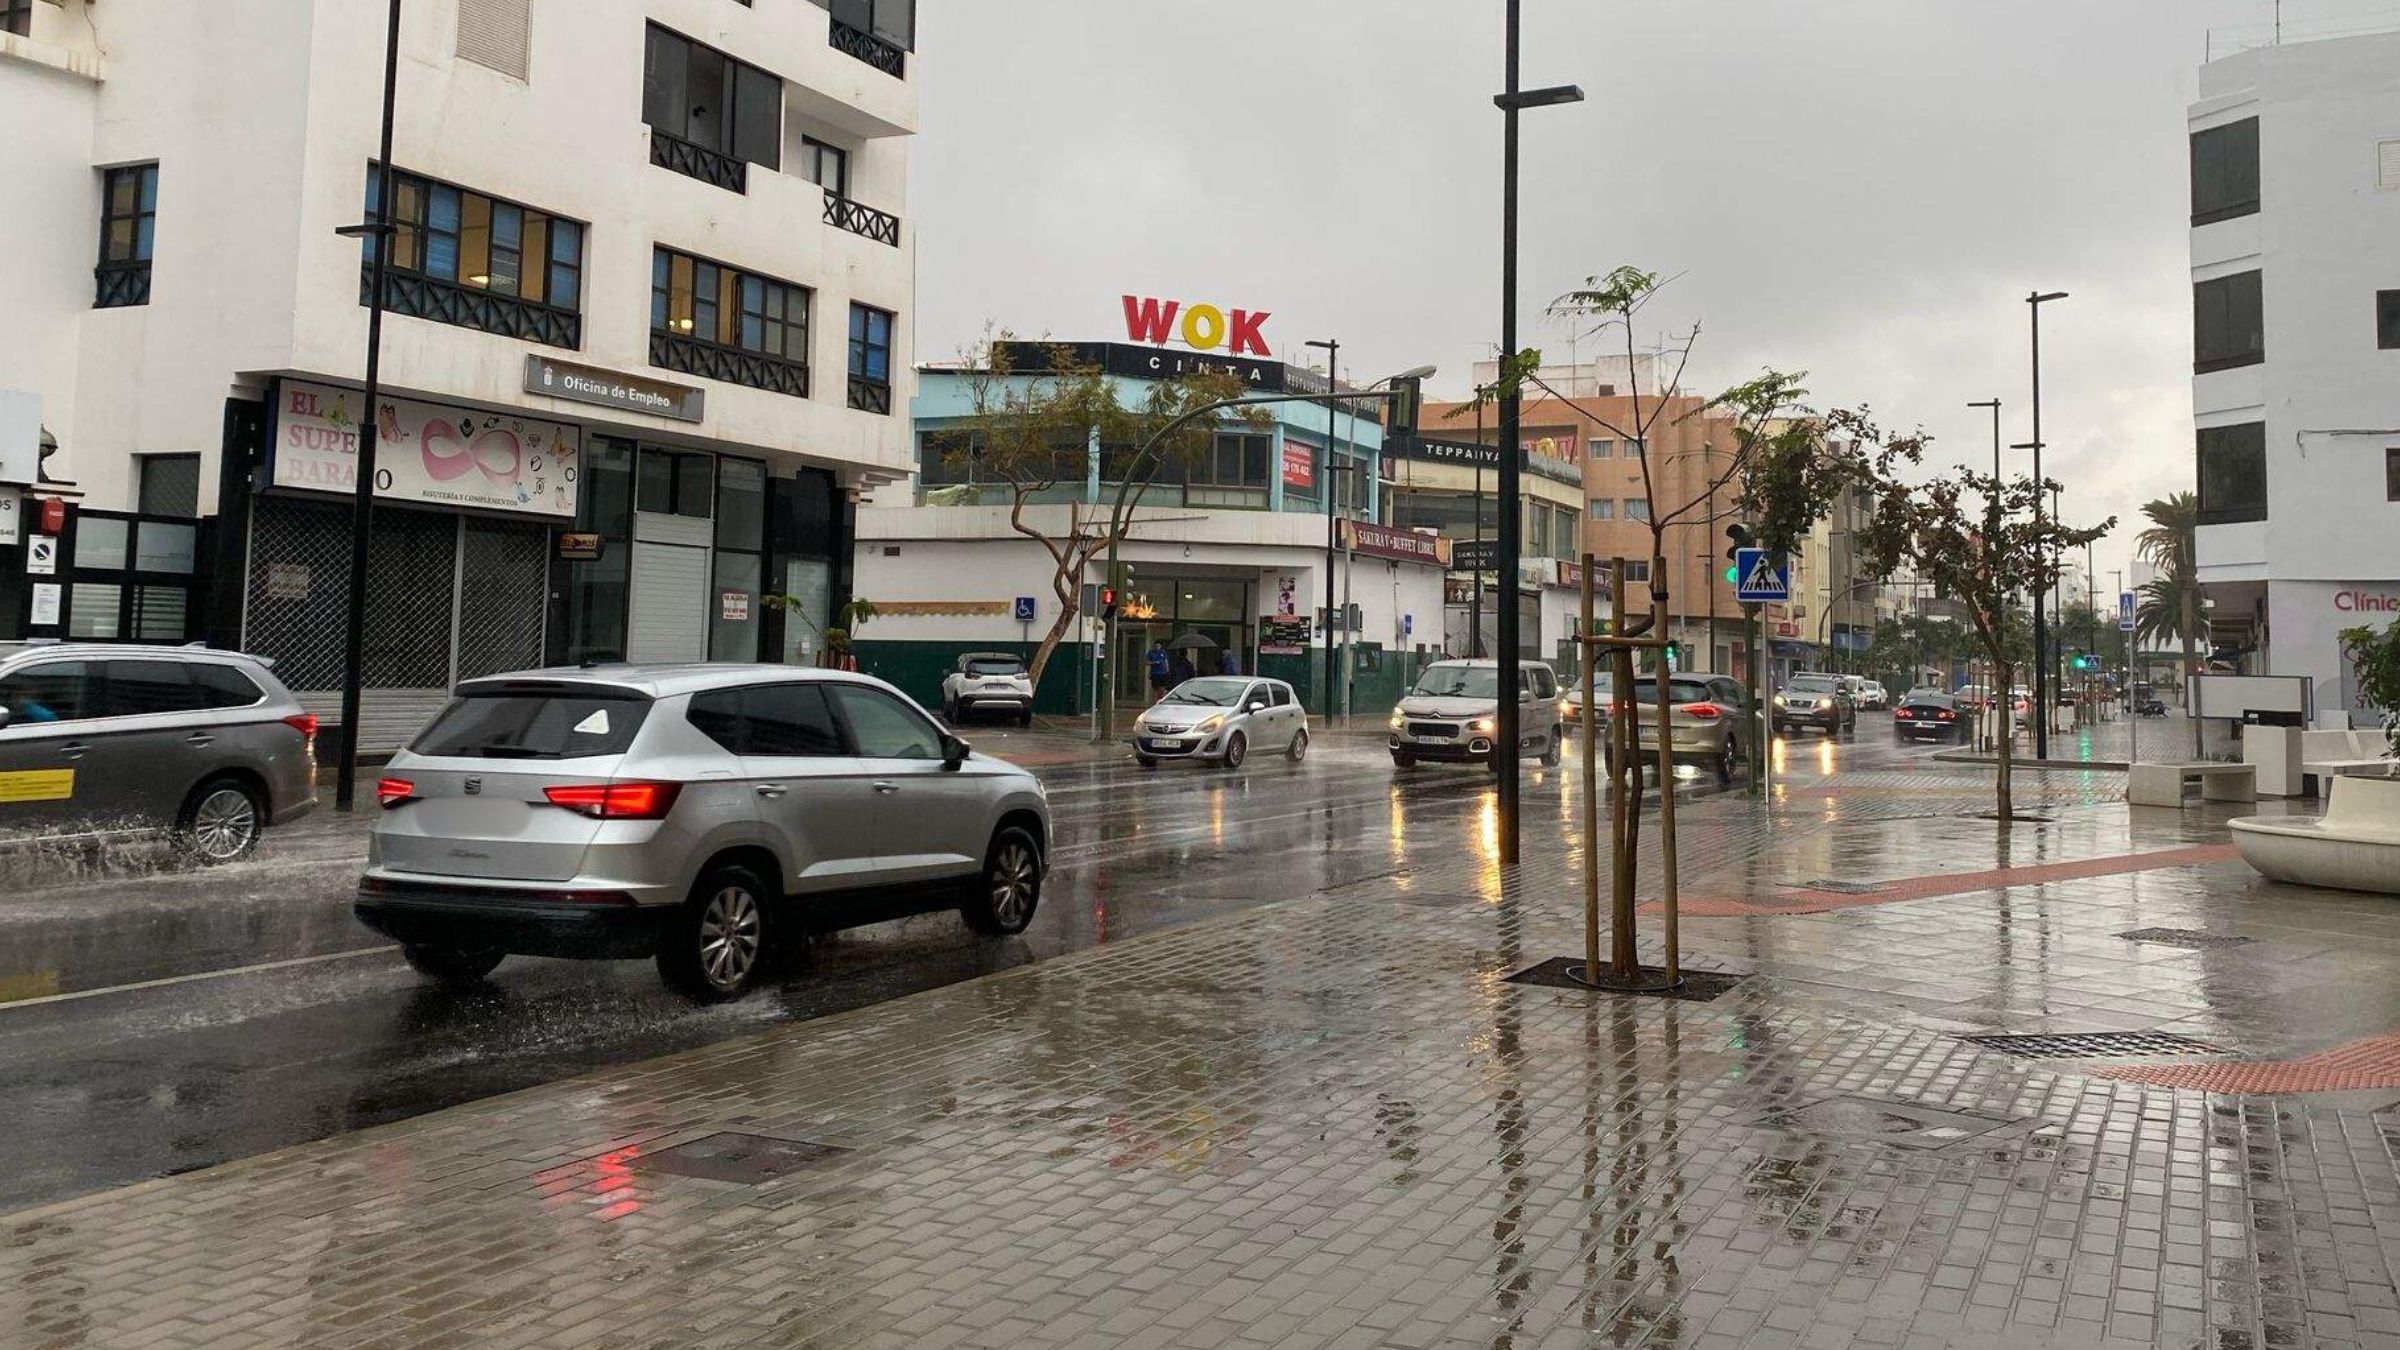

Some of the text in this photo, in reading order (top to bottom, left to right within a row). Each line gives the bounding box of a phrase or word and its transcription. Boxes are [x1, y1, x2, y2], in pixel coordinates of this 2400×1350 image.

[1122, 295, 1271, 357] WOK
[1149, 356, 1261, 381] CINTA
[289, 390, 322, 418] EL
[564, 375, 671, 407] Oficina de Empleo
[288, 424, 359, 455] SUPE
[287, 458, 393, 491] BARAO
[1393, 536, 1416, 553] BUFFET
[1417, 541, 1435, 556] LIBRE
